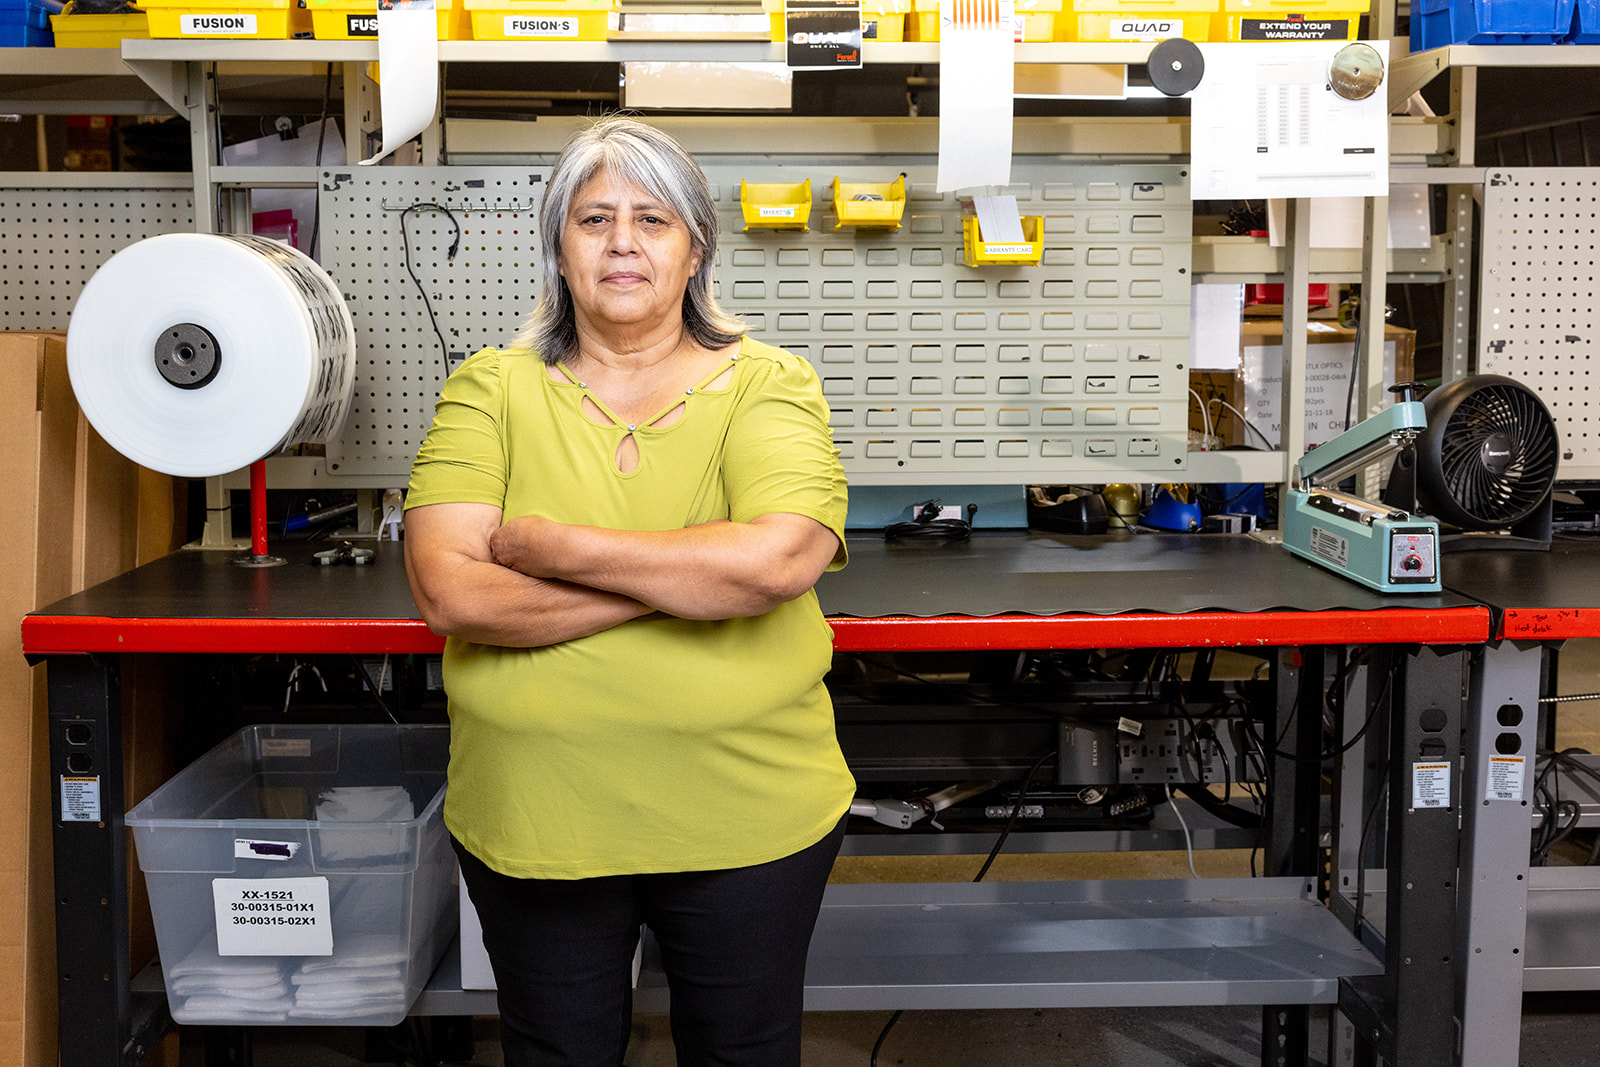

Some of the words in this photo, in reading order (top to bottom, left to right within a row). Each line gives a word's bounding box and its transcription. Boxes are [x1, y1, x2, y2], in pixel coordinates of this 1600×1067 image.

[193, 17, 244, 29] FUSION
[1121, 23, 1171, 33] QUAD
[1259, 22, 1301, 30] EXTEND
[1303, 22, 1332, 30] YOUR
[1265, 31, 1325, 39] WARRANTY
[1257, 400, 1271, 408] QTY
[1257, 411, 1273, 419] Date
[1307, 422, 1318, 431] IN
[1328, 420, 1358, 431] CHIA
[241, 890, 294, 900] XX-1521
[231, 902, 315, 912] 30-00315-01X1
[232, 916, 317, 926] 30-00315-02X1
